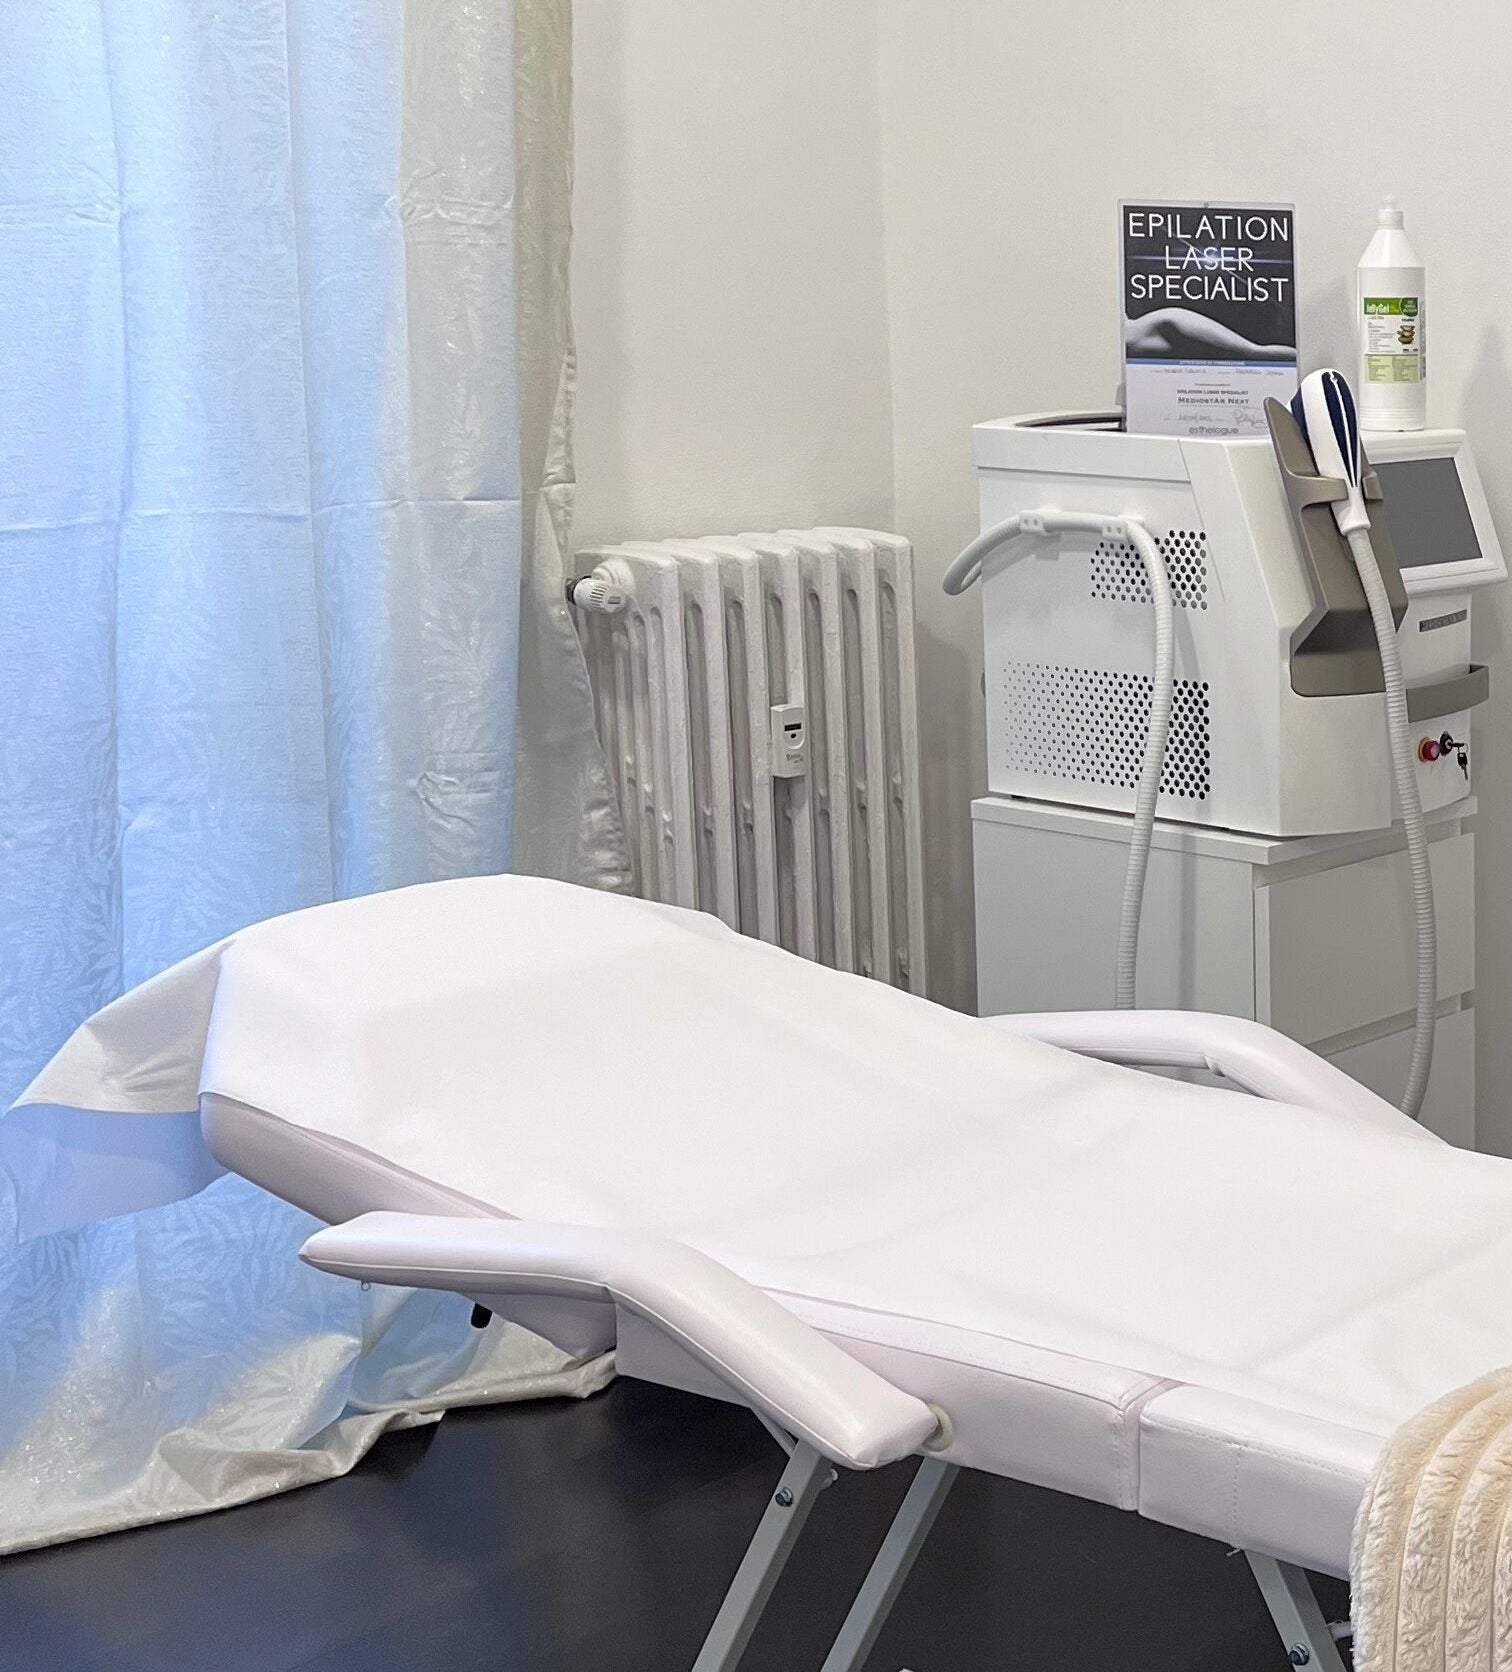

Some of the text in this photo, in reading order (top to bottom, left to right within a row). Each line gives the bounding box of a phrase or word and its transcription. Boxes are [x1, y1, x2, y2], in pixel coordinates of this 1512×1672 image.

[1128, 213, 1289, 242] EPILATION
[1165, 245, 1254, 272] LASER
[1130, 274, 1289, 302] SPECIALIST
